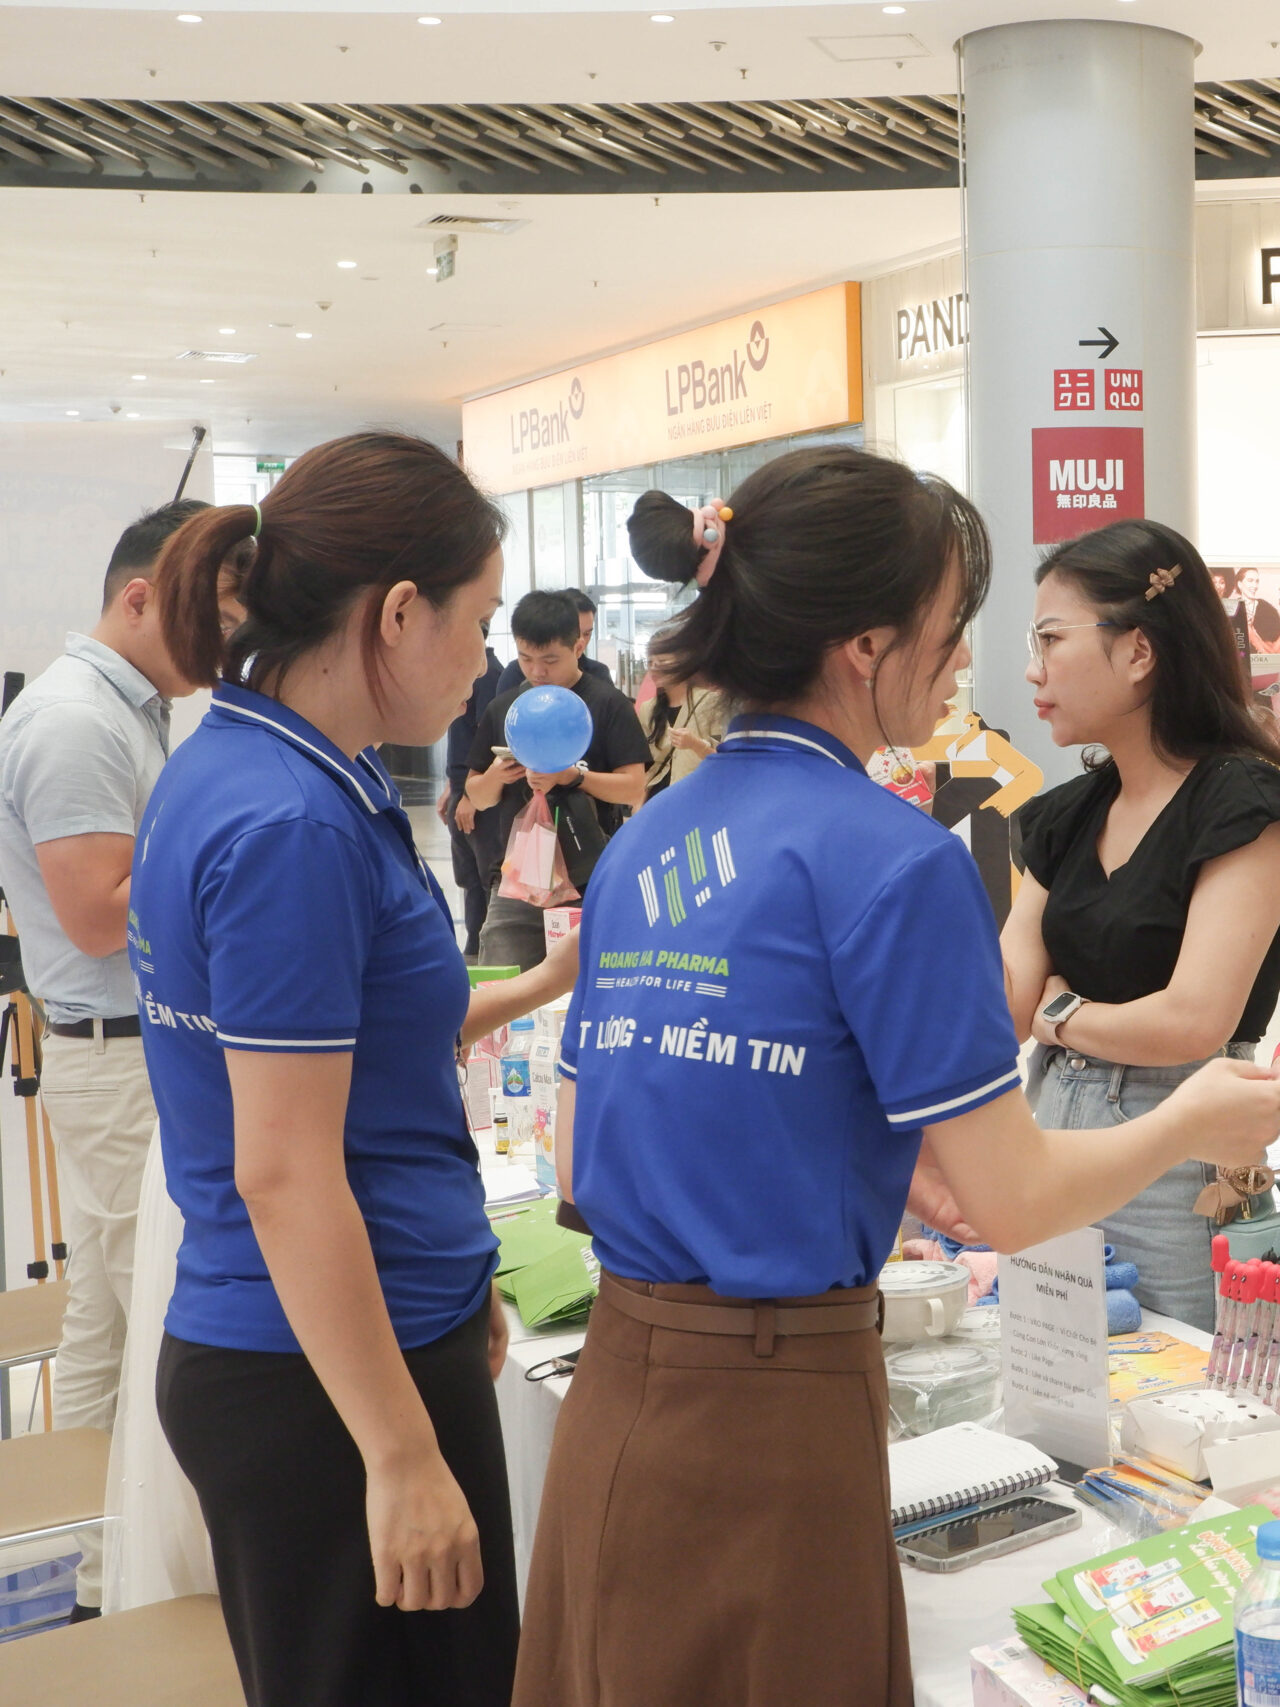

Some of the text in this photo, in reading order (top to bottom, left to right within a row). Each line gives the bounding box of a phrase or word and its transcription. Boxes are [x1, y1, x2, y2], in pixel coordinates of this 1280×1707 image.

[897, 293, 970, 360] PAND
[665, 348, 748, 417] LPBank
[1110, 373, 1138, 388] UNI
[1109, 392, 1140, 408] QLO
[511, 399, 570, 455] LPBank
[1049, 459, 1124, 491] MUJI
[1056, 493, 1118, 509] 無印良品
[656, 950, 729, 976] PHARMA
[640, 976, 661, 987] FOR
[666, 979, 692, 992] LIFE
[659, 1017, 738, 1066] NIỀM
[748, 1039, 806, 1076] TIN
